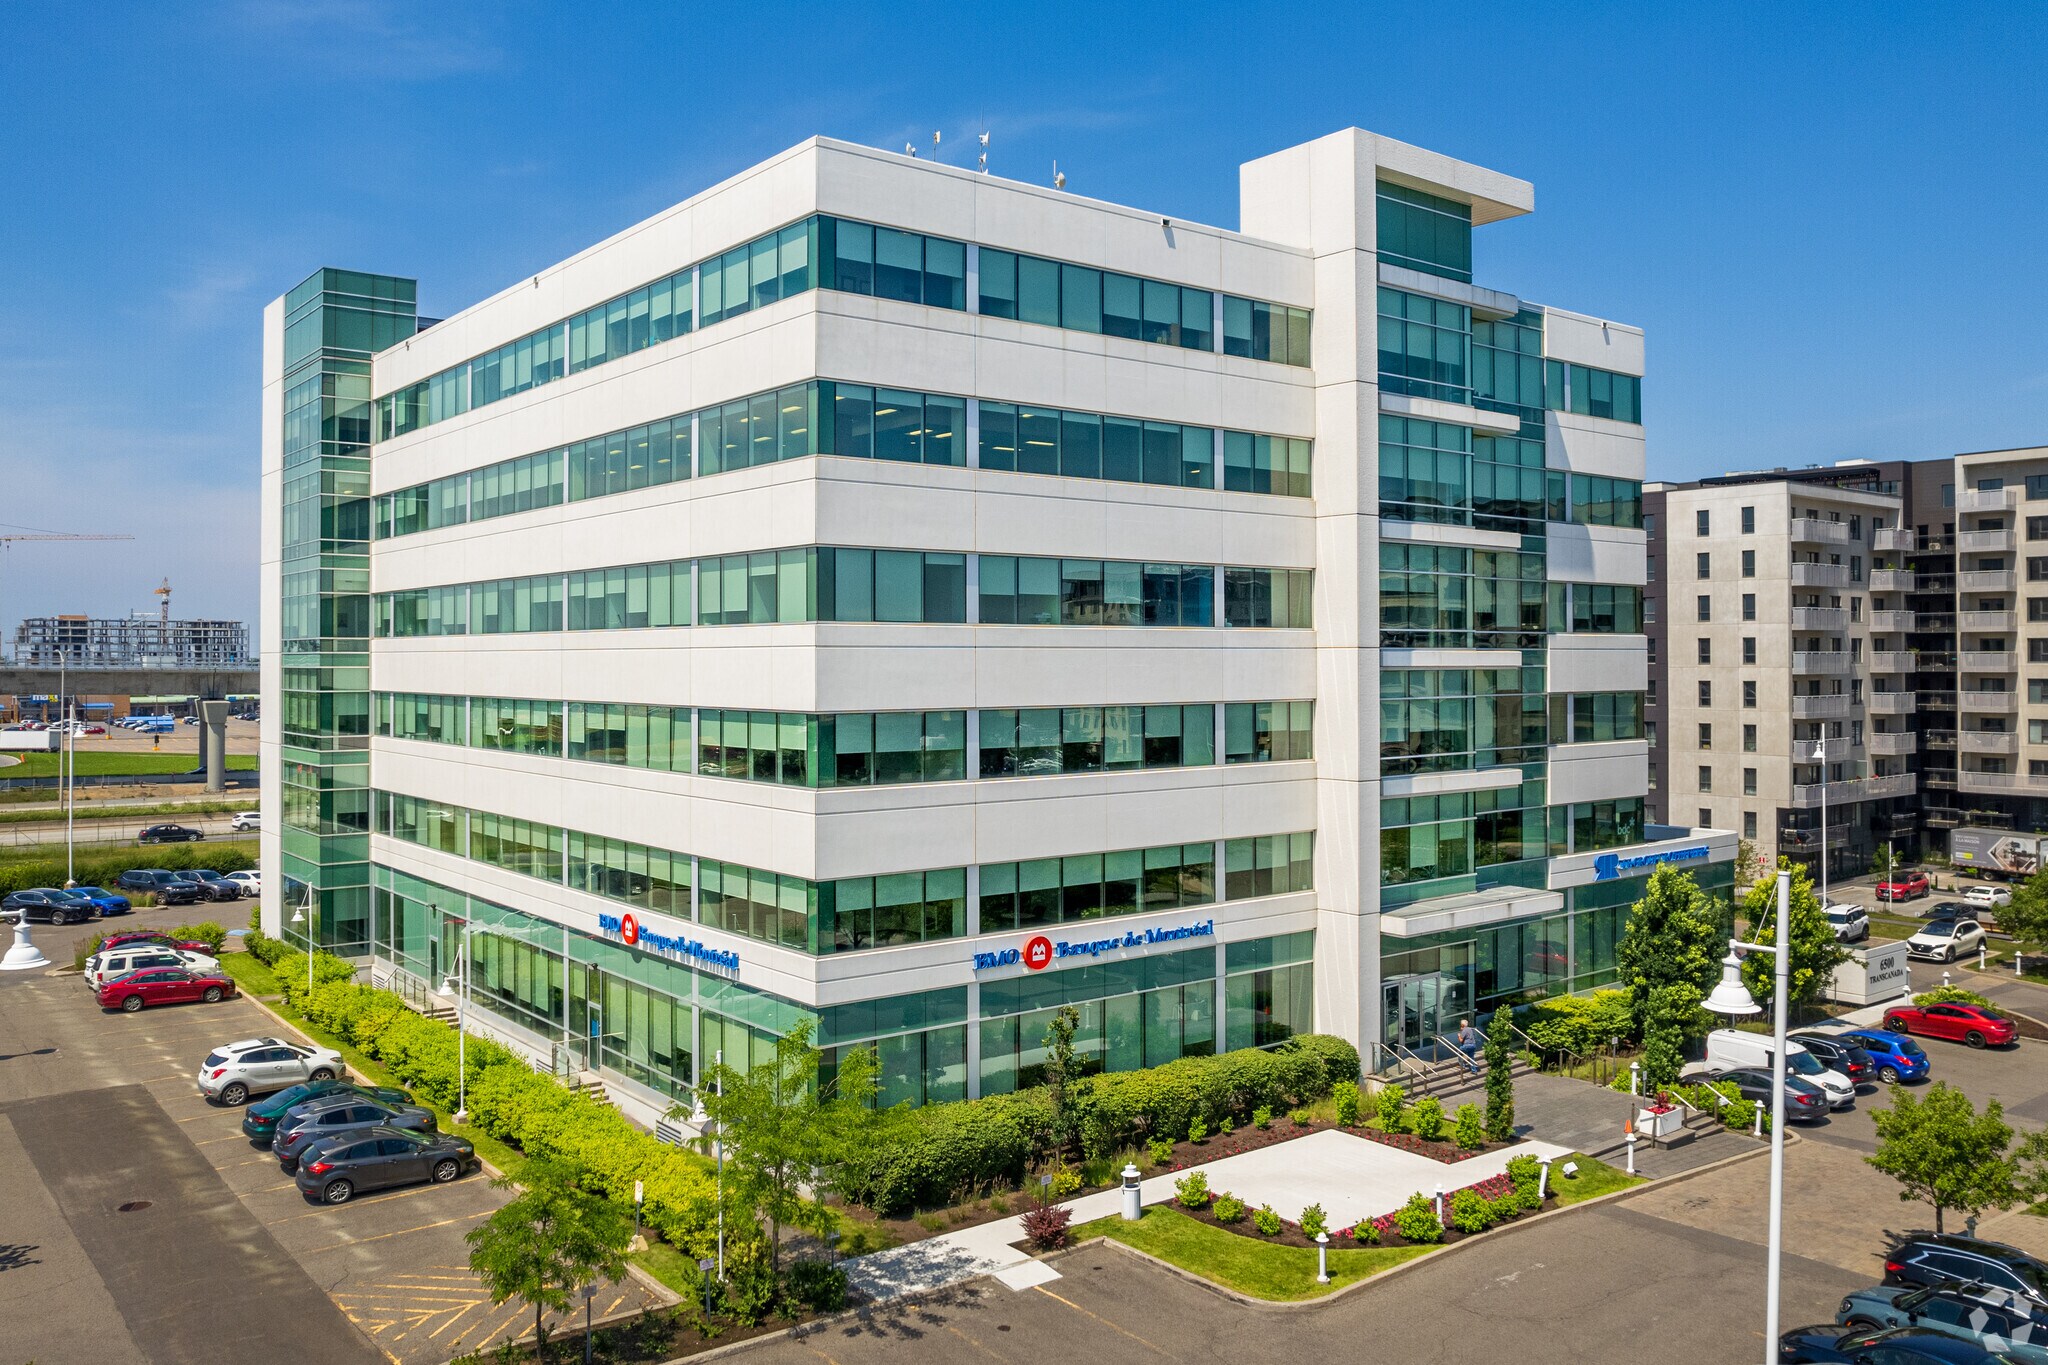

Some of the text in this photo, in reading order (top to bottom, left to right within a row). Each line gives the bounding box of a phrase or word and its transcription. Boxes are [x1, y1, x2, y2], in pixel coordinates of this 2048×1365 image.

[973, 919, 1214, 970] BMO Banque de Montréal
[1880, 956, 1895, 971] 6500
[1869, 969, 1904, 983] TRANSCANADA
